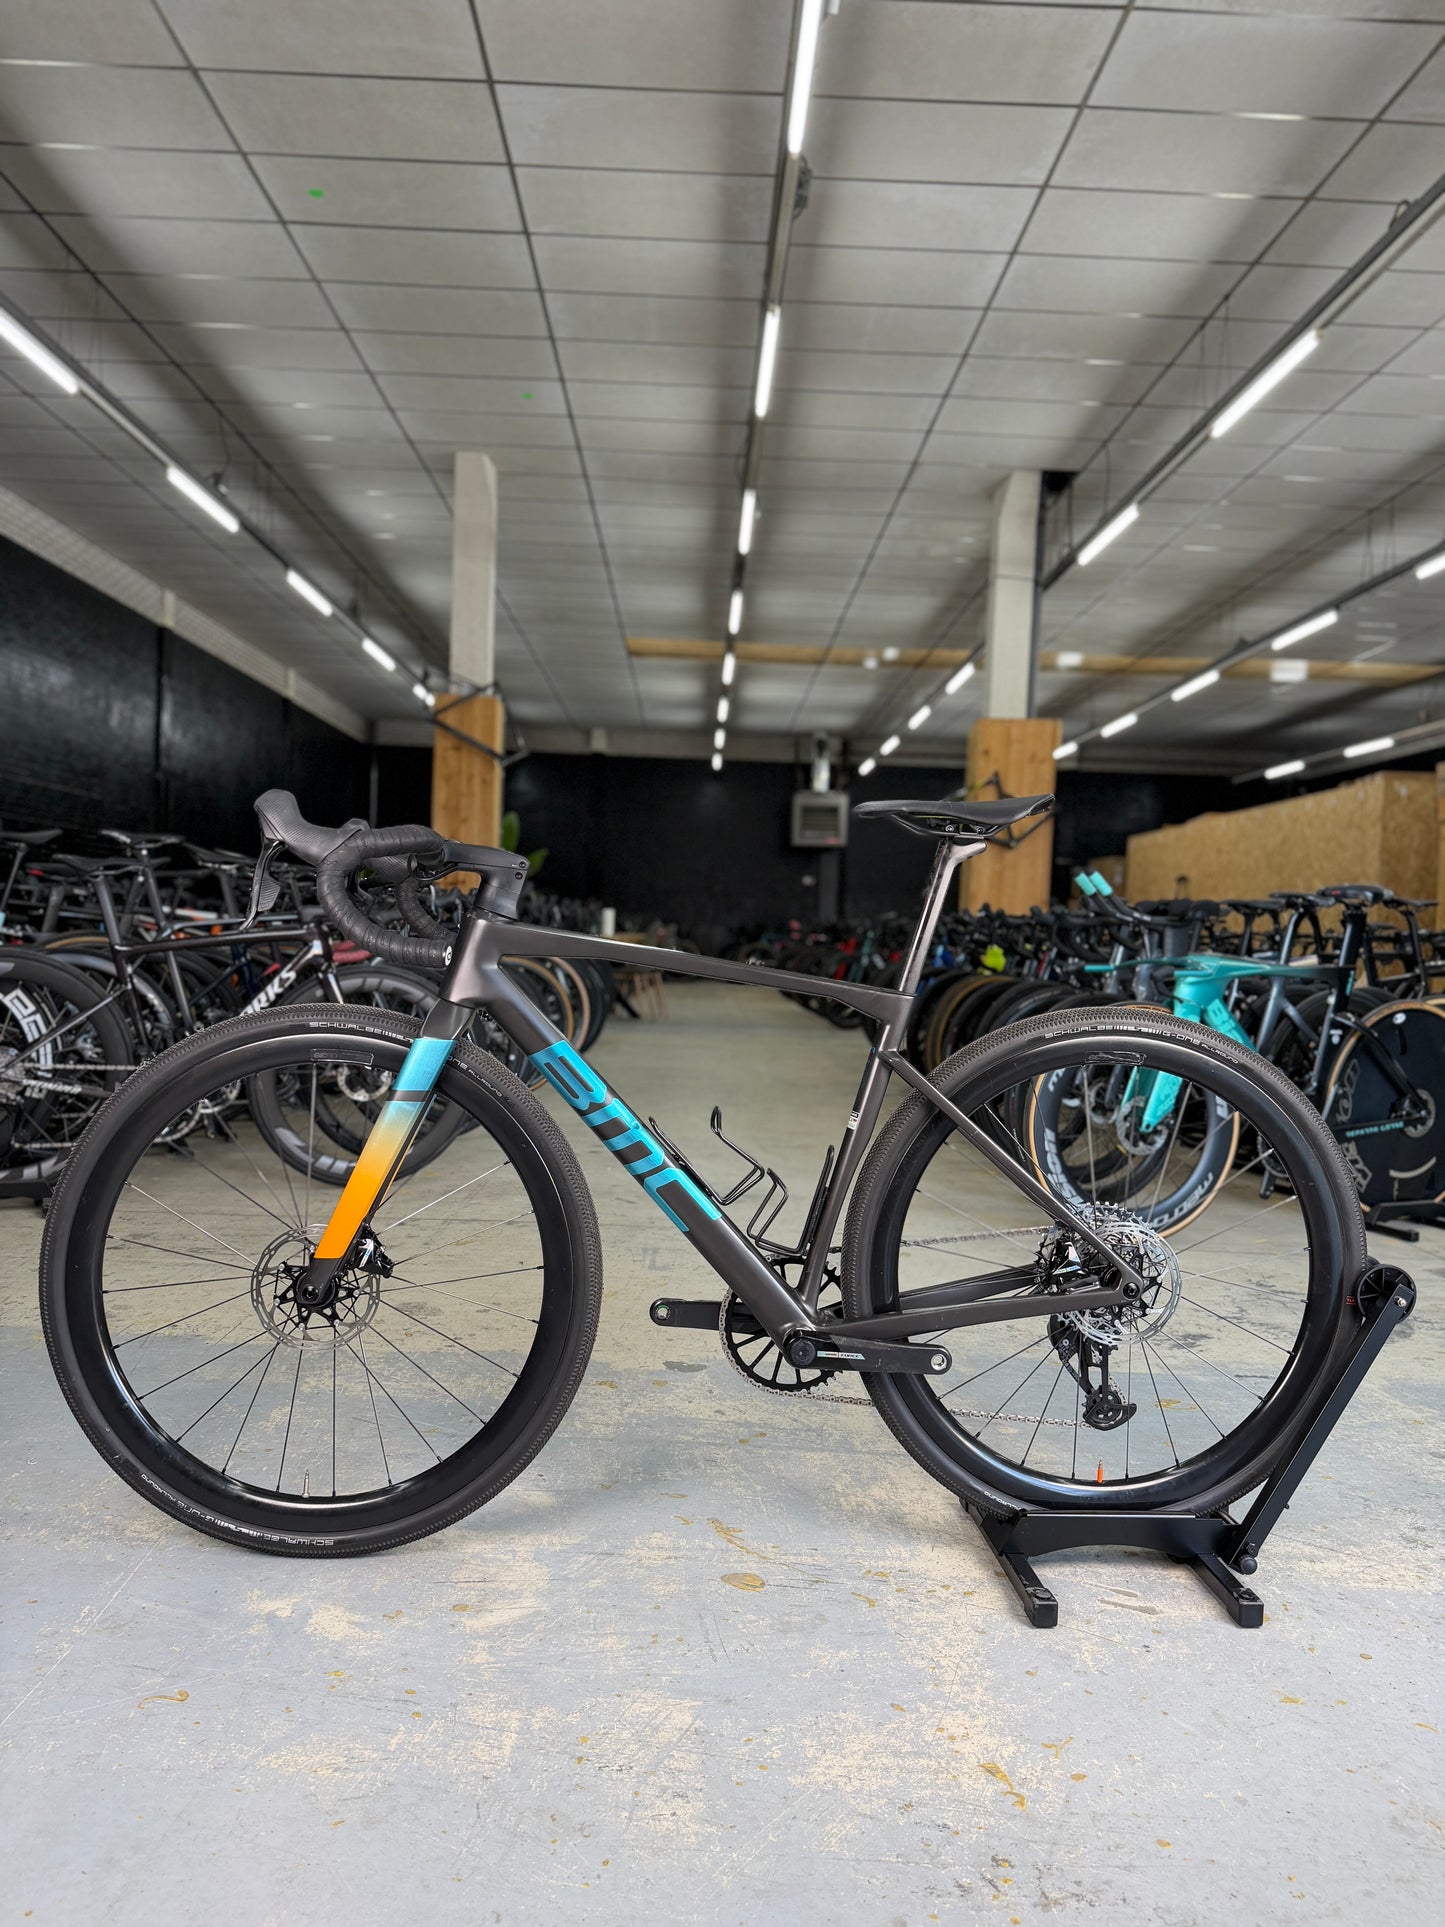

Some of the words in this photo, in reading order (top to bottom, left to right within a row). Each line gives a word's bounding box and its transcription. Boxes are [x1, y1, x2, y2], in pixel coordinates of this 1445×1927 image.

[309, 1021, 382, 1035] SCHWALBE
[1044, 1024, 1114, 1039] SCHWALBE
[1162, 1030, 1201, 1046] G-ONE
[1201, 1043, 1239, 1065] ALLROUND
[1149, 1171, 1214, 1229] metro
[140, 1473, 177, 1503] ALLROUND
[178, 1500, 215, 1523] G-ONE
[262, 1532, 335, 1547] SCHWALBE
